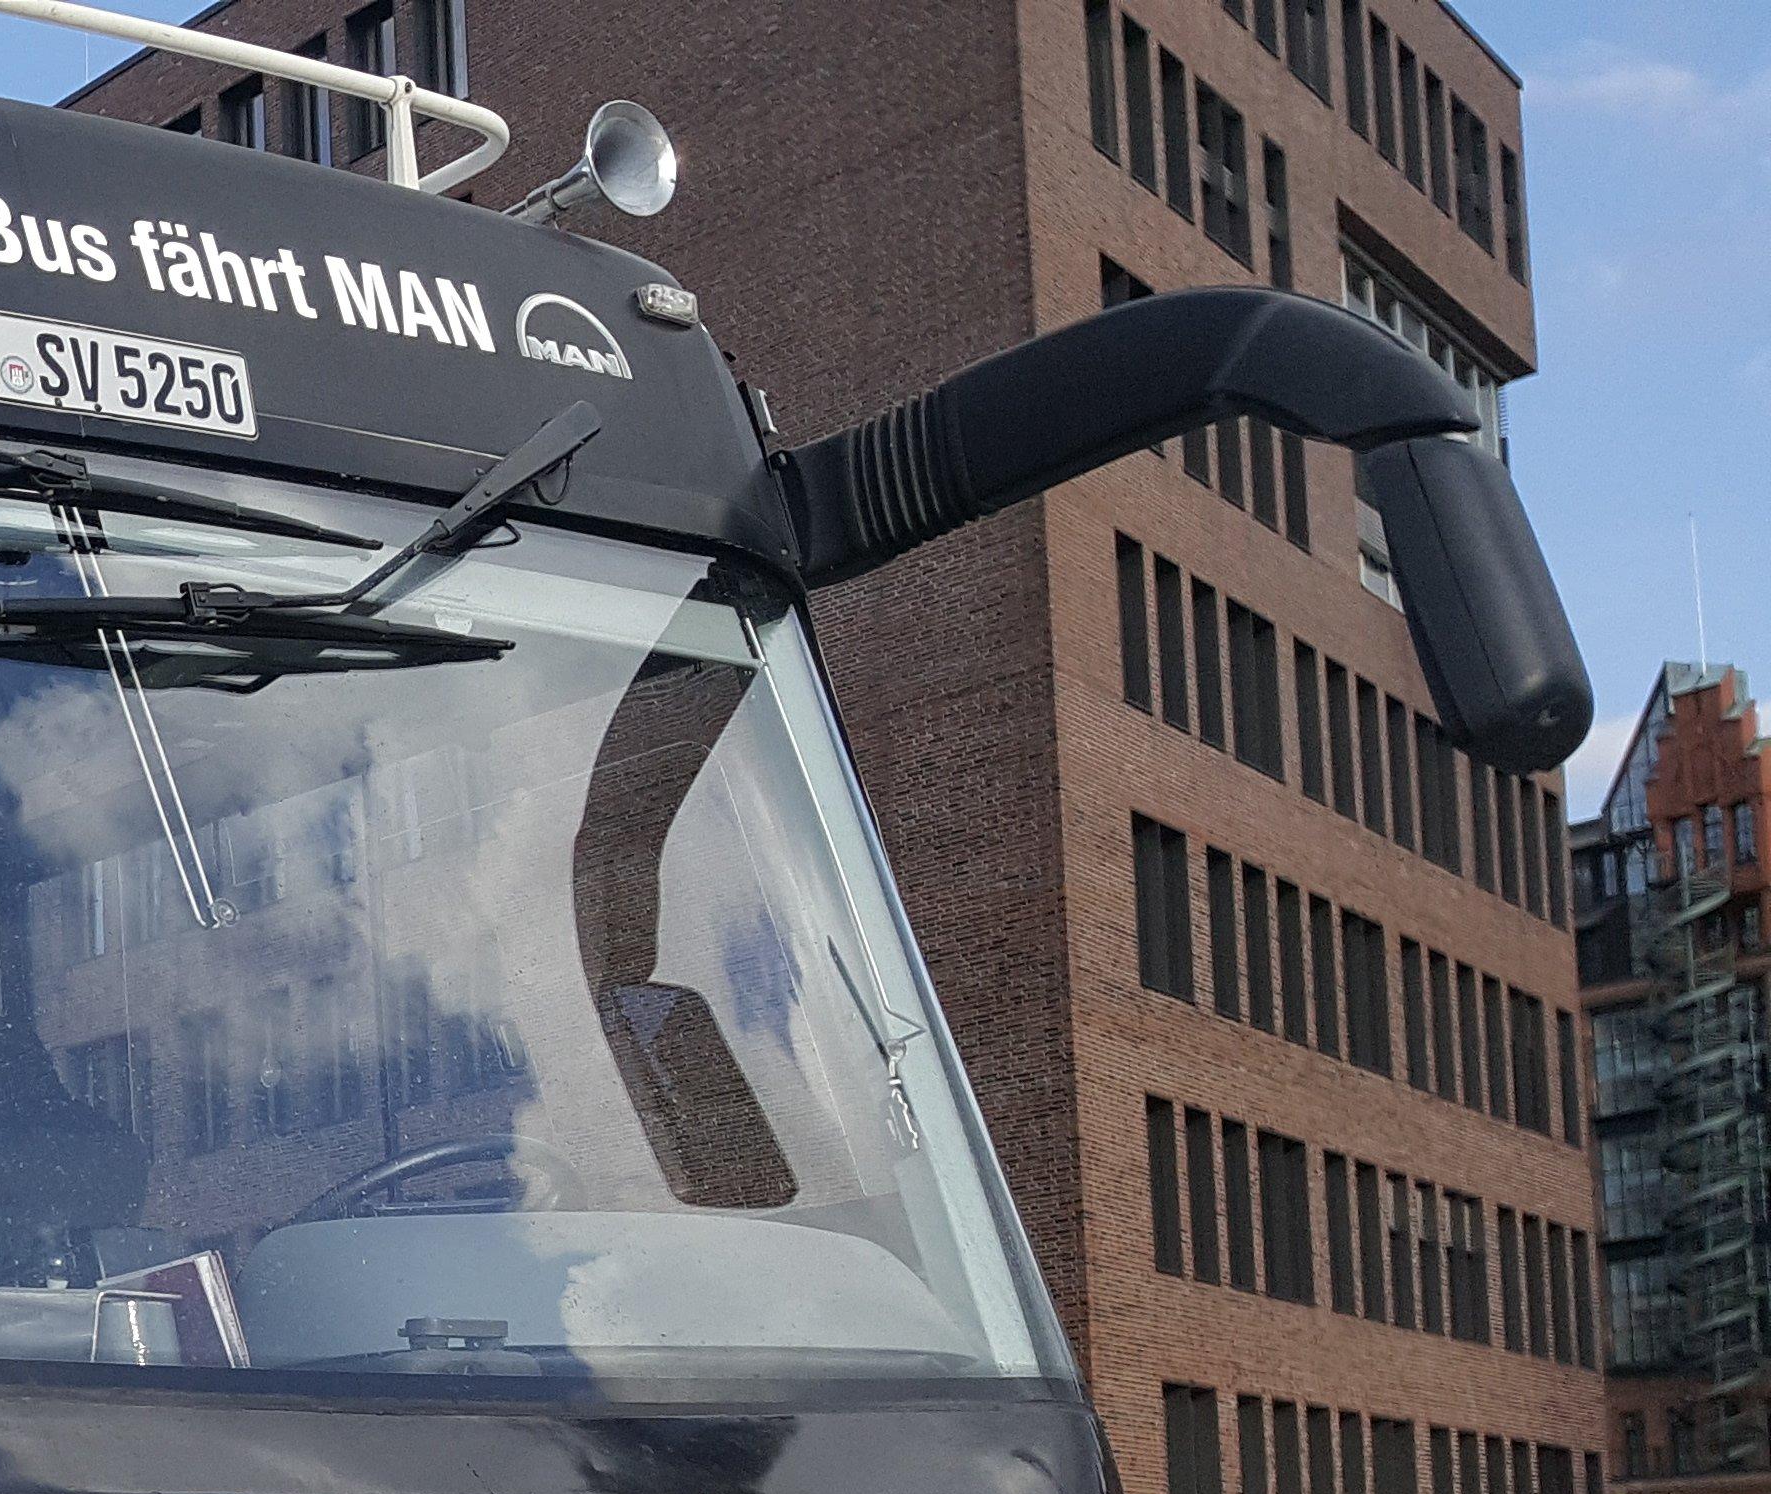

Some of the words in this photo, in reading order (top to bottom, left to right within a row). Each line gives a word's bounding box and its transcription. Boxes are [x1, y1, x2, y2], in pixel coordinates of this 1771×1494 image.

[130, 220, 317, 319] fährt
[324, 255, 496, 353] MAN
[36, 333, 100, 403] SV
[114, 345, 245, 424] 5250
[526, 335, 623, 378] MAN
